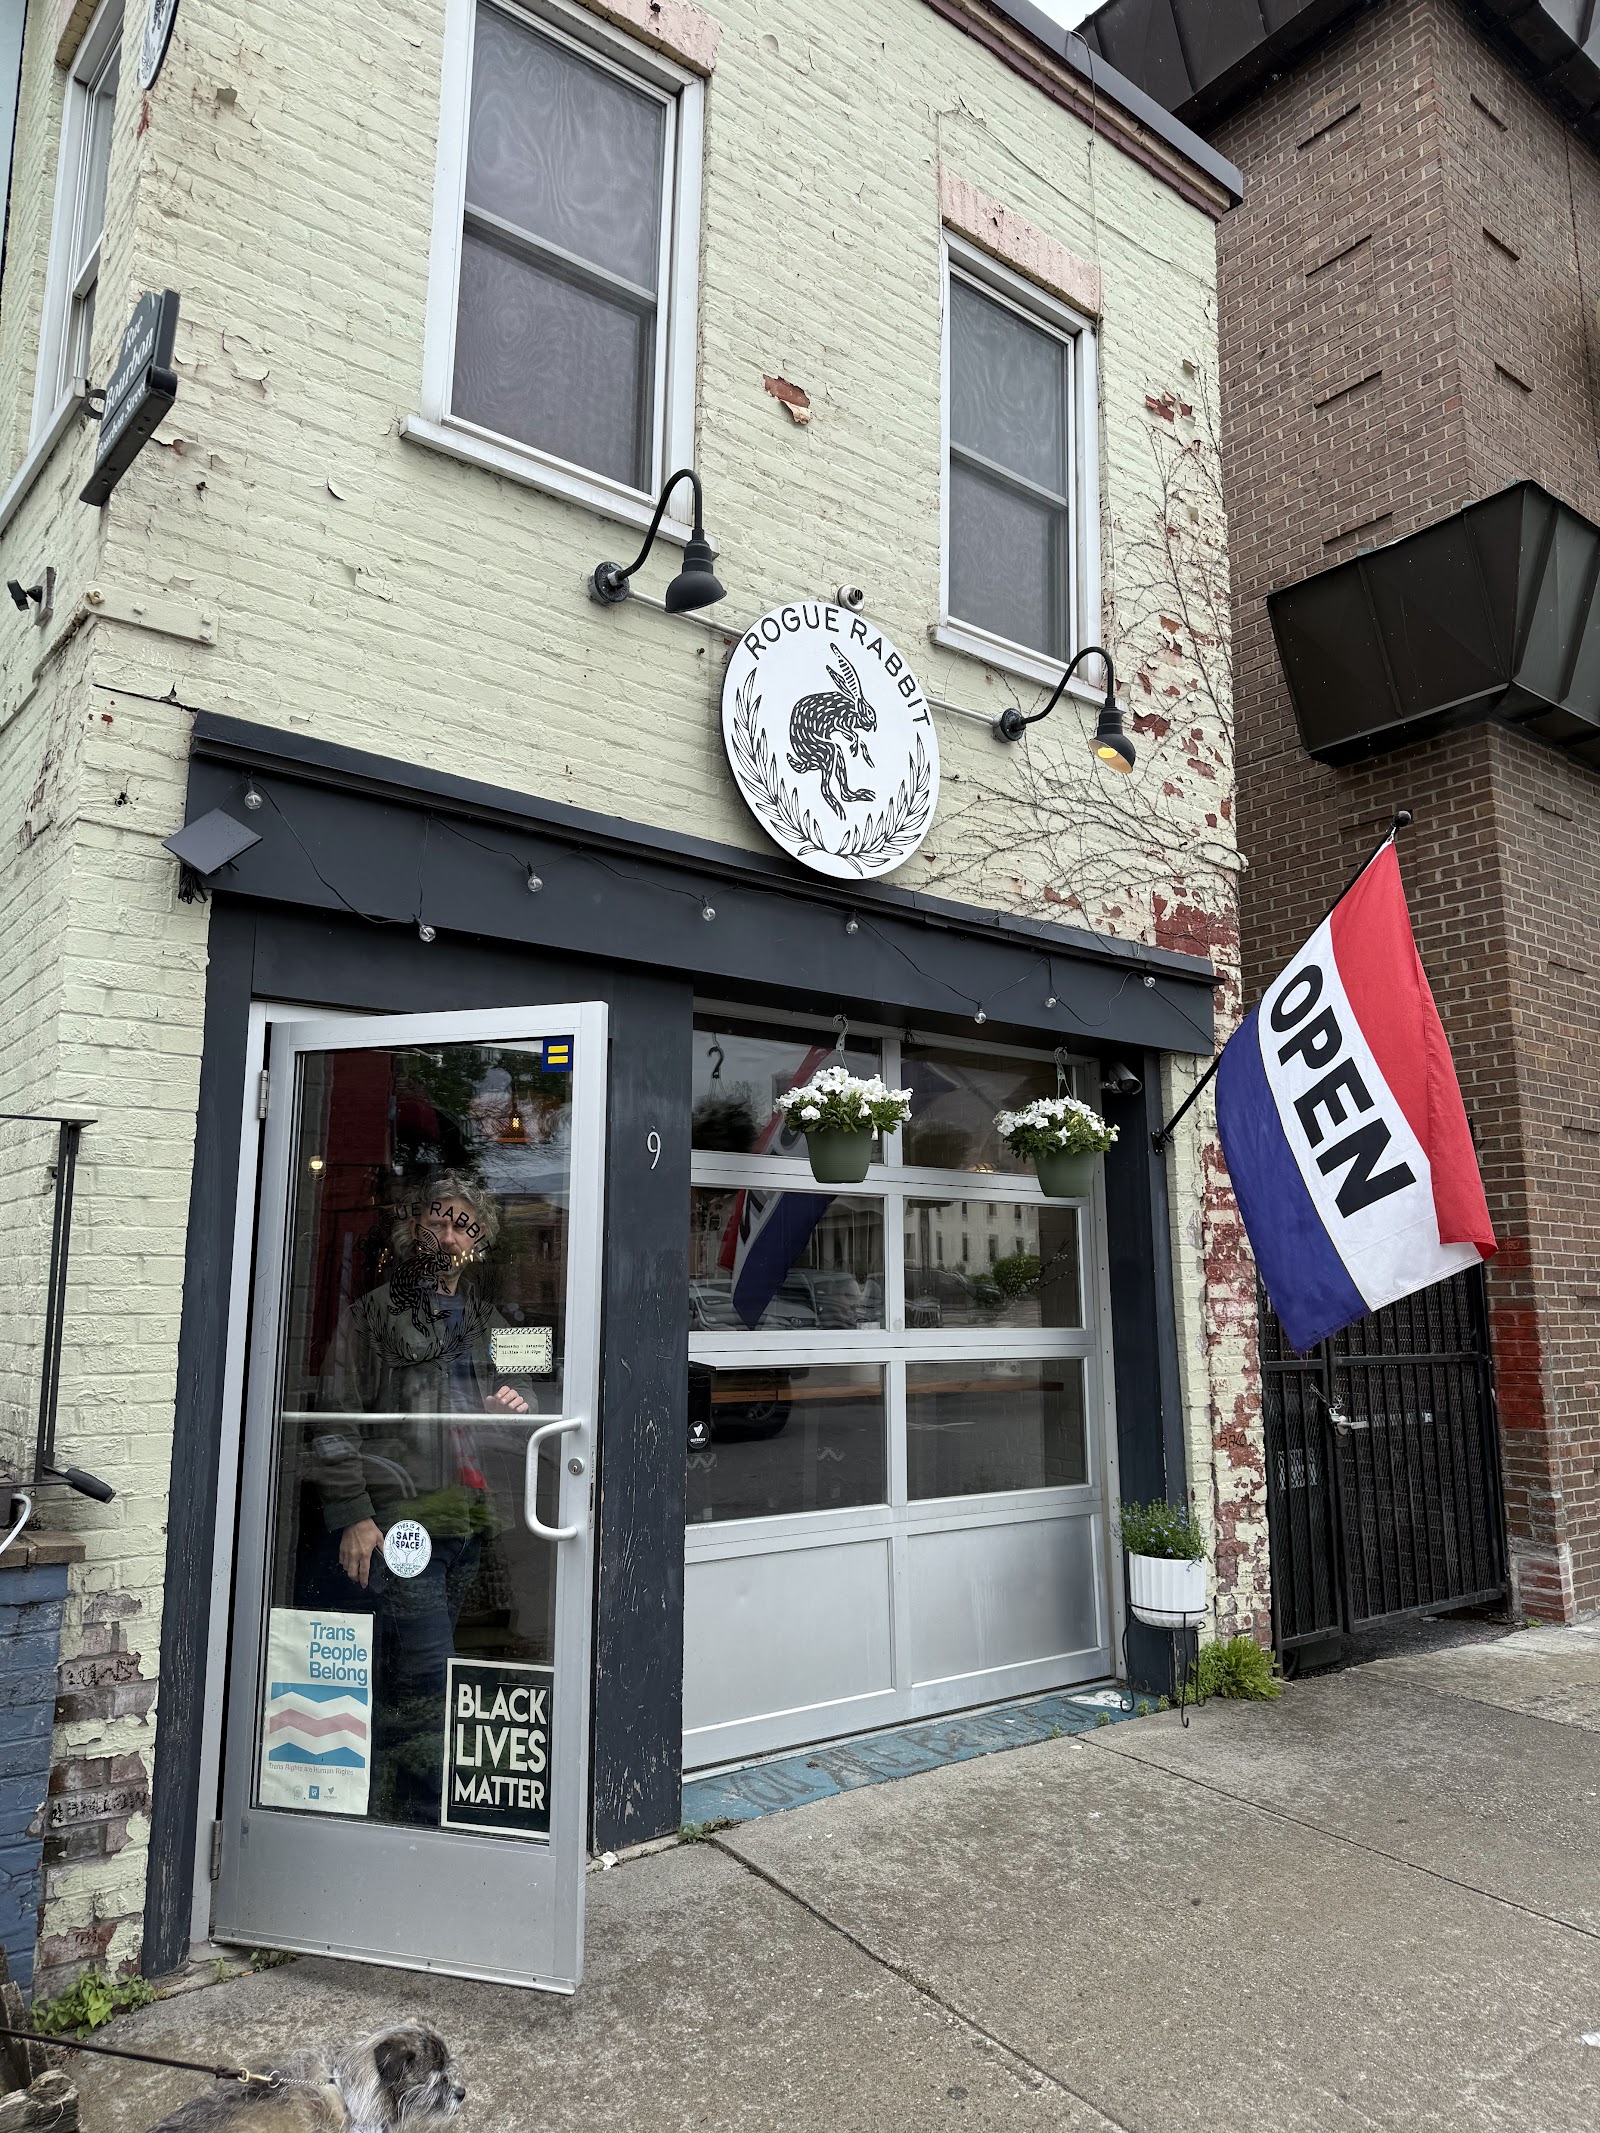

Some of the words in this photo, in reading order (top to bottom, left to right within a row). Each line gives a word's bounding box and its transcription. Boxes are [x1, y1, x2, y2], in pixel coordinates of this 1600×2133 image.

[124, 315, 143, 355] Rue
[103, 327, 154, 421] Bourbon
[96, 412, 125, 461] Bourbon
[125, 377, 146, 418] Street
[744, 604, 840, 660] ROGUE
[849, 618, 931, 727] RABBIT
[1270, 964, 1417, 1219] OPEN
[647, 1131, 661, 1170] 9
[358, 1201, 422, 1253] ROGUE
[429, 1201, 497, 1254] RABBIT
[395, 1540, 420, 1550] SPACE
[396, 1531, 420, 1541] SAFE
[310, 1621, 356, 1642] Trans
[310, 1641, 368, 1665] People
[310, 1661, 368, 1687] Belong
[457, 1683, 547, 1725] BLACK
[455, 1723, 547, 1774] LIVES
[268, 1762, 284, 1770] Trans
[285, 1763, 303, 1772] Rights
[313, 1766, 334, 1775] Human
[335, 1767, 354, 1777] Rights
[454, 1772, 546, 1811] MATTER
